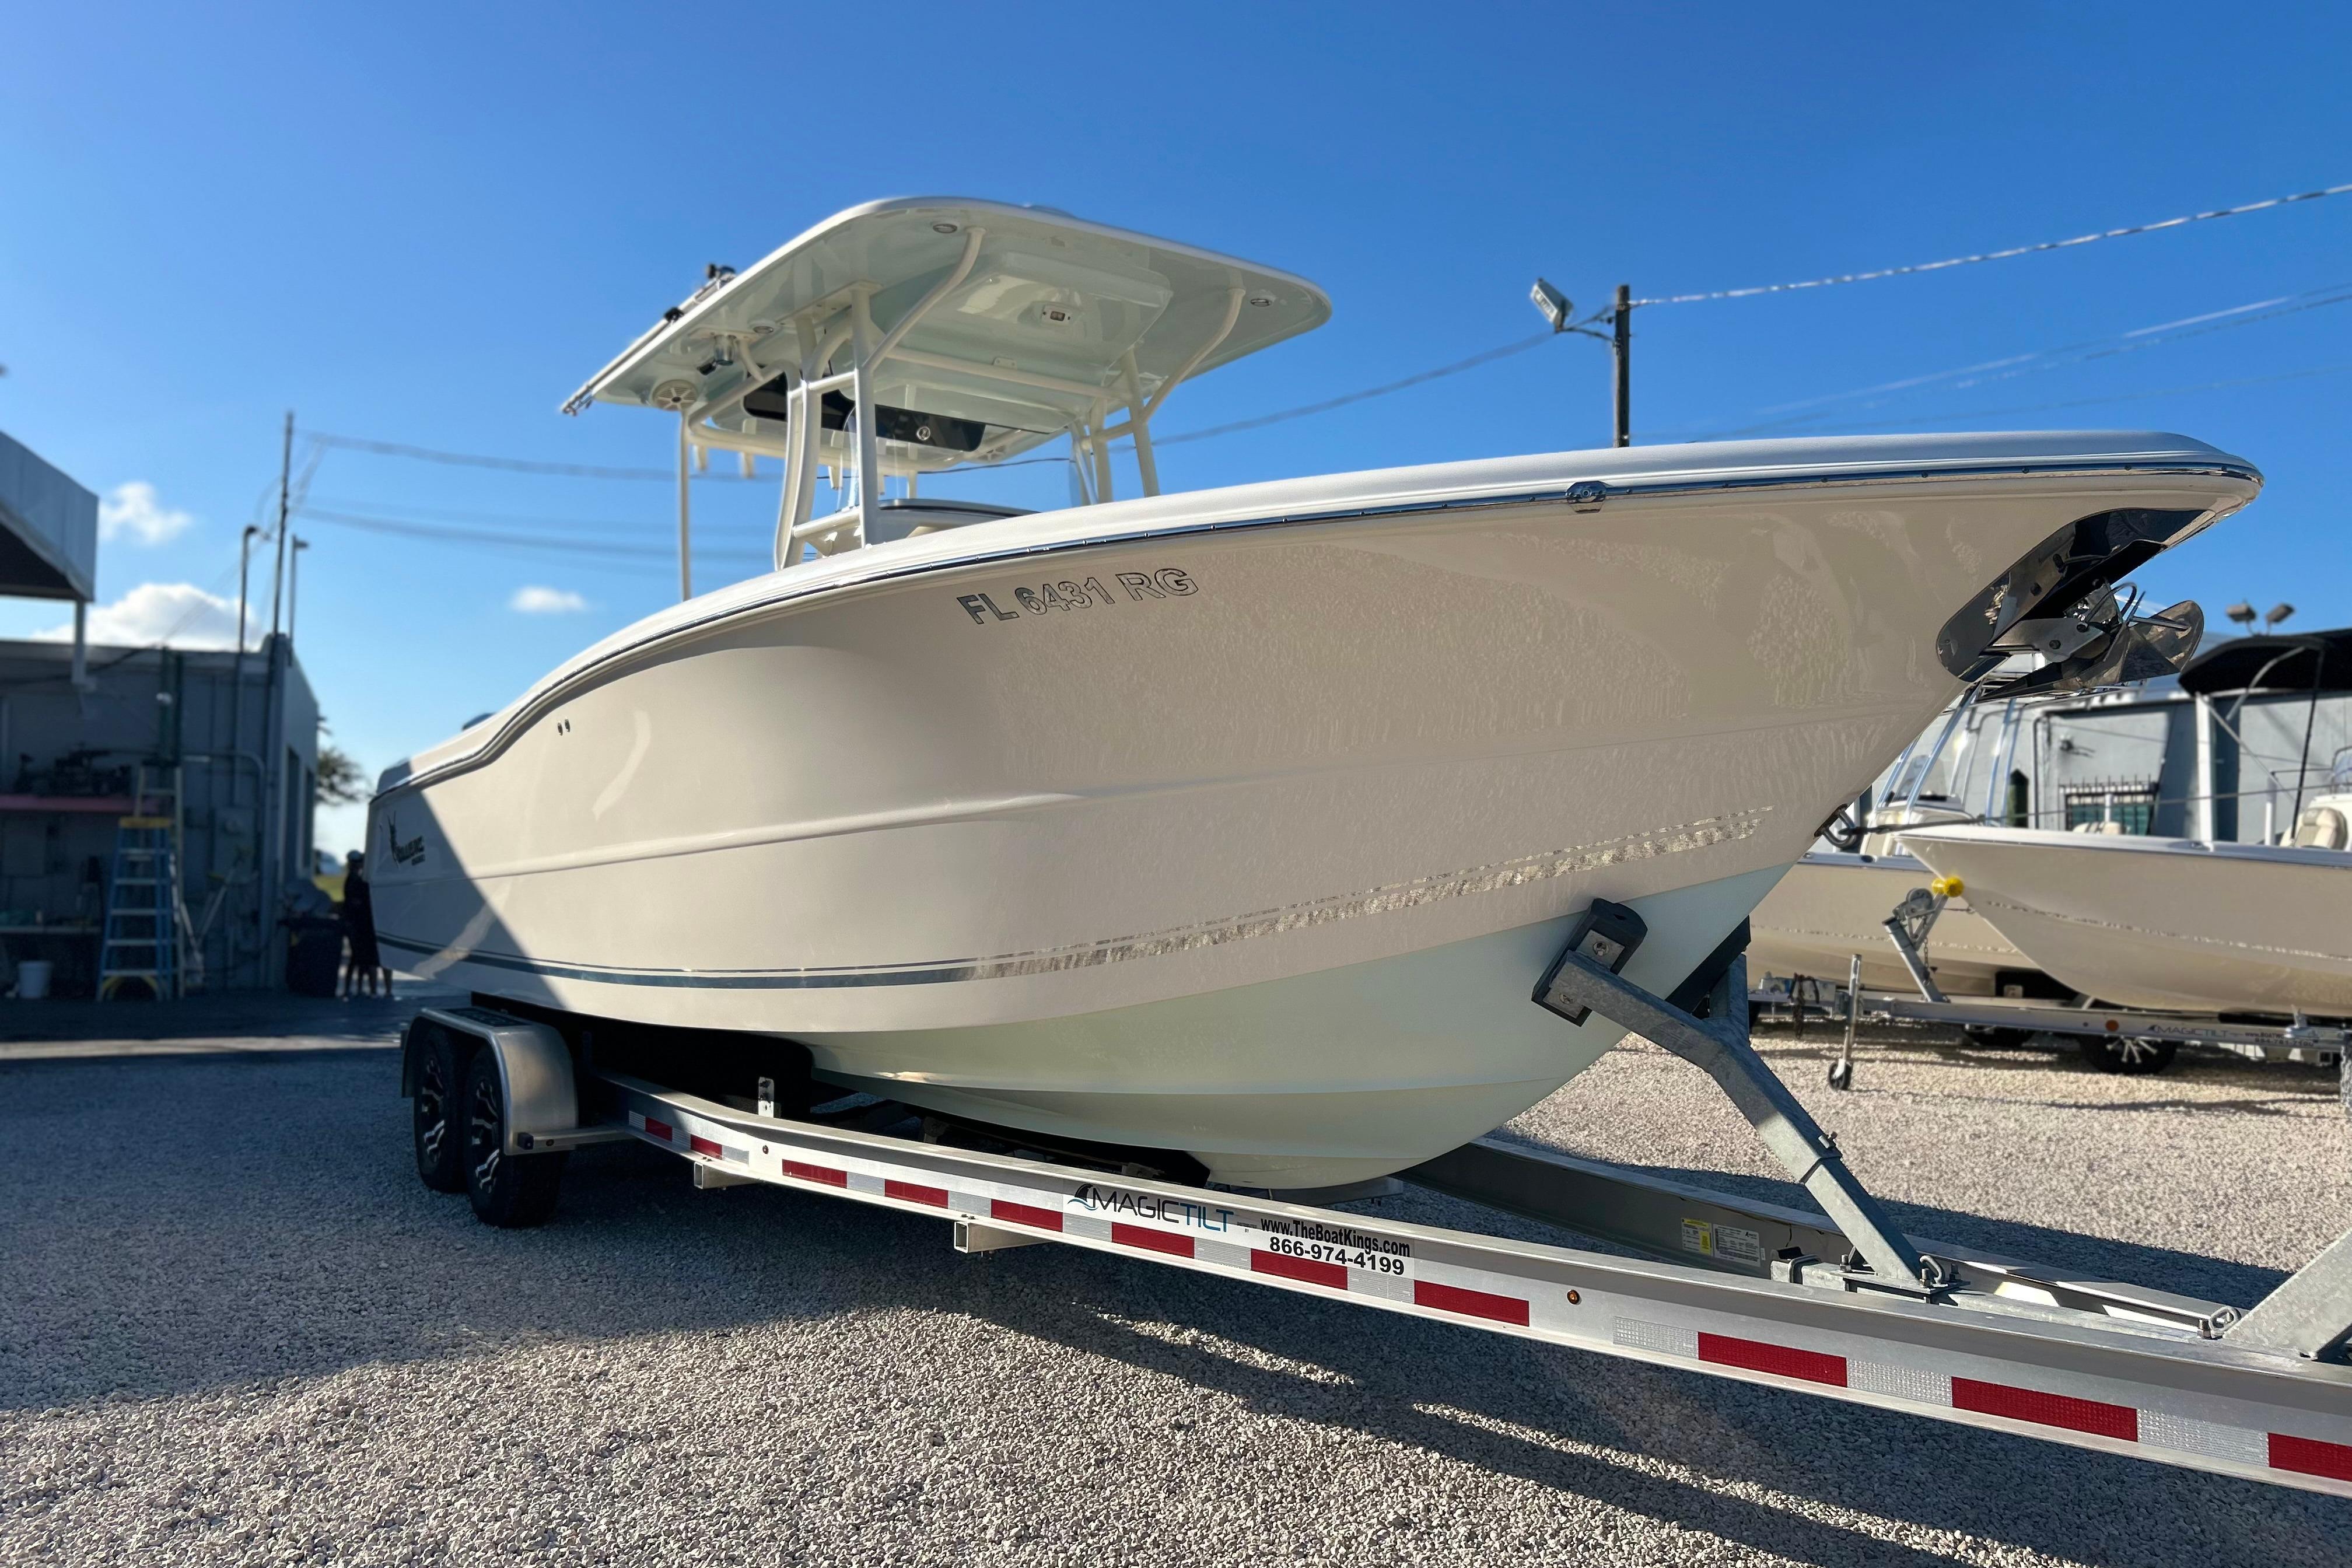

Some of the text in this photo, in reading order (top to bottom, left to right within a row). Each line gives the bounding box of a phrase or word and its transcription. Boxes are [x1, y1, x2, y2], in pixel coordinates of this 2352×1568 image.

[956, 568, 1199, 625] FL 6431 RG
[2157, 1026, 2228, 1038] MAGICTILT
[1092, 1187, 1234, 1233] MAGICTILT
[1261, 1218, 1410, 1257] www.TheBoatKings.com
[1270, 1236, 1405, 1276] 866-974-4199
